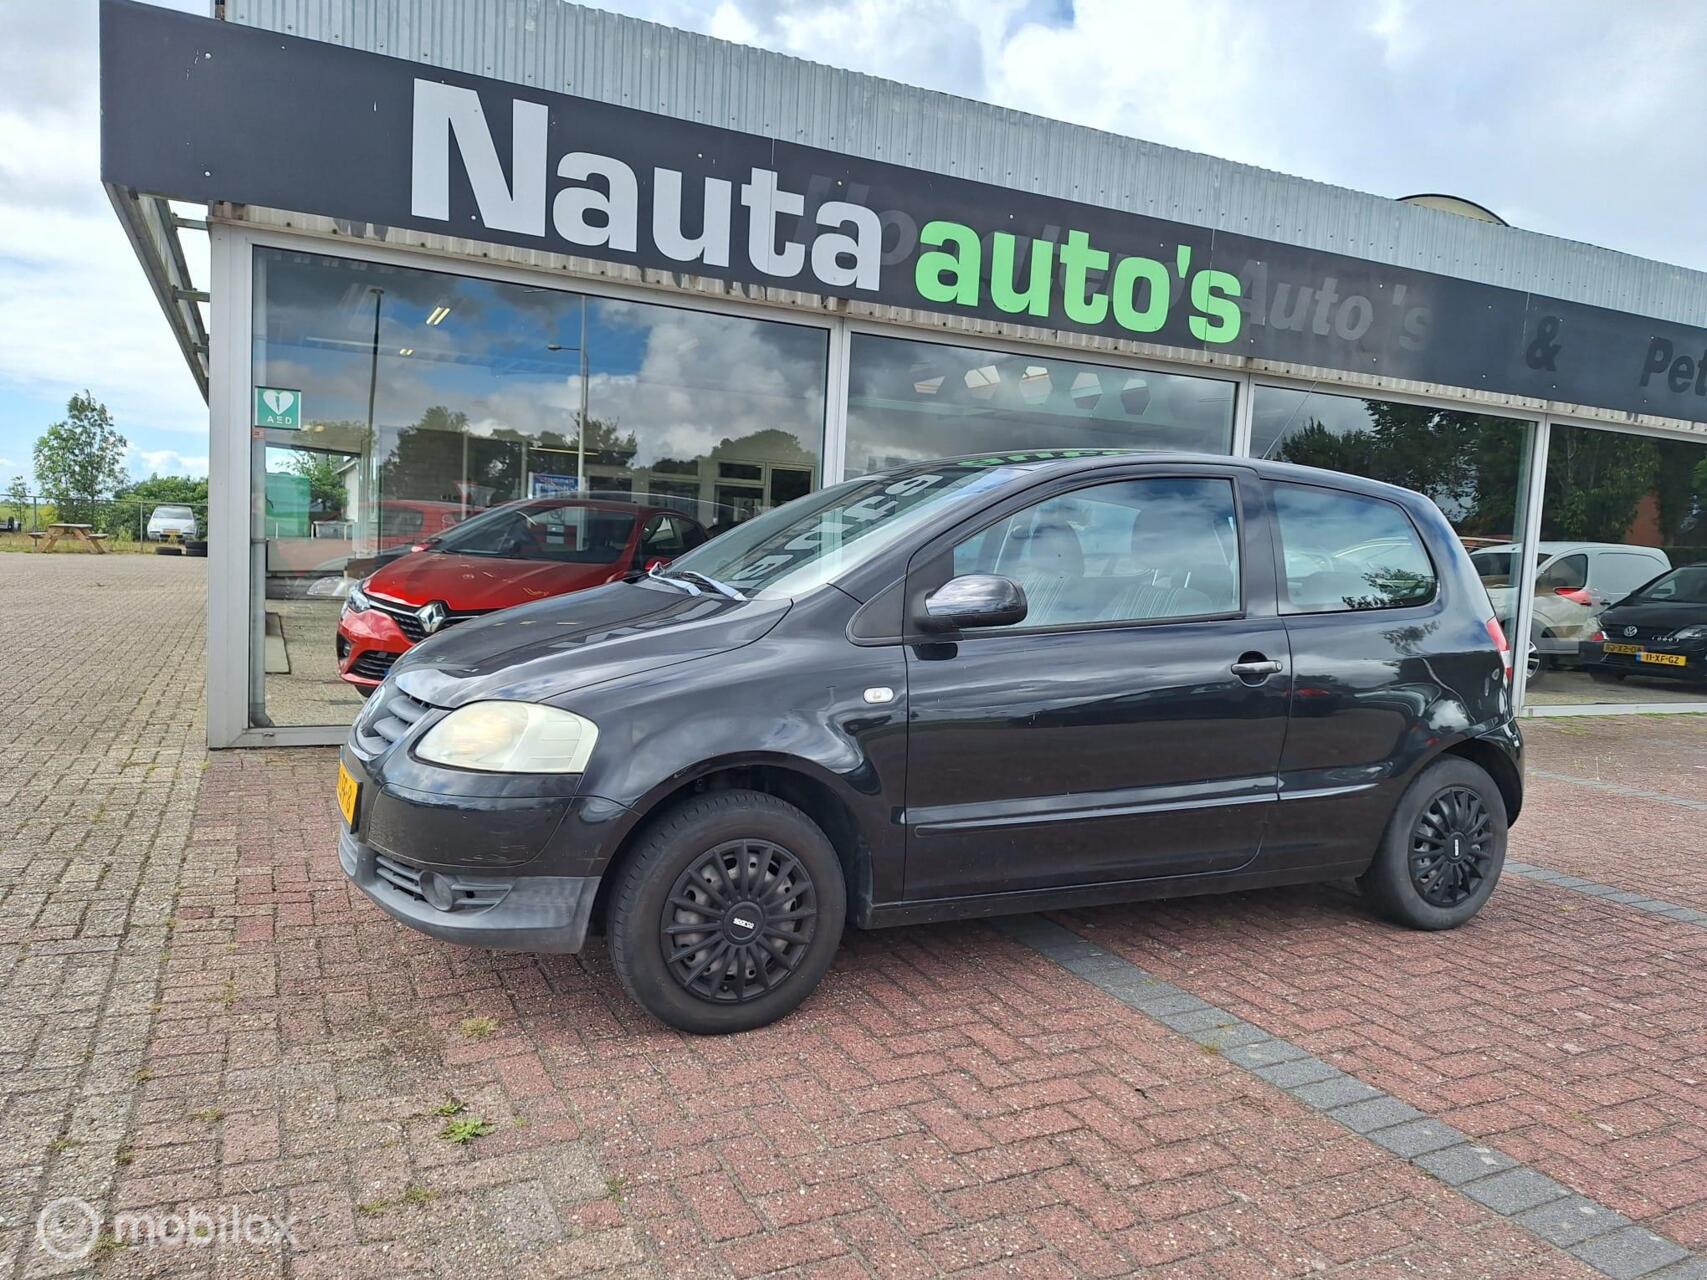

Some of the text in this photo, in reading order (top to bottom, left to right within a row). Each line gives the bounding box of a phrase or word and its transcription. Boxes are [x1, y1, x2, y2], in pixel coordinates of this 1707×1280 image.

[411, 77, 883, 292] Nauta
[914, 219, 1243, 344] auto's
[1239, 258, 1375, 342] Auto
[266, 415, 292, 425] AED
